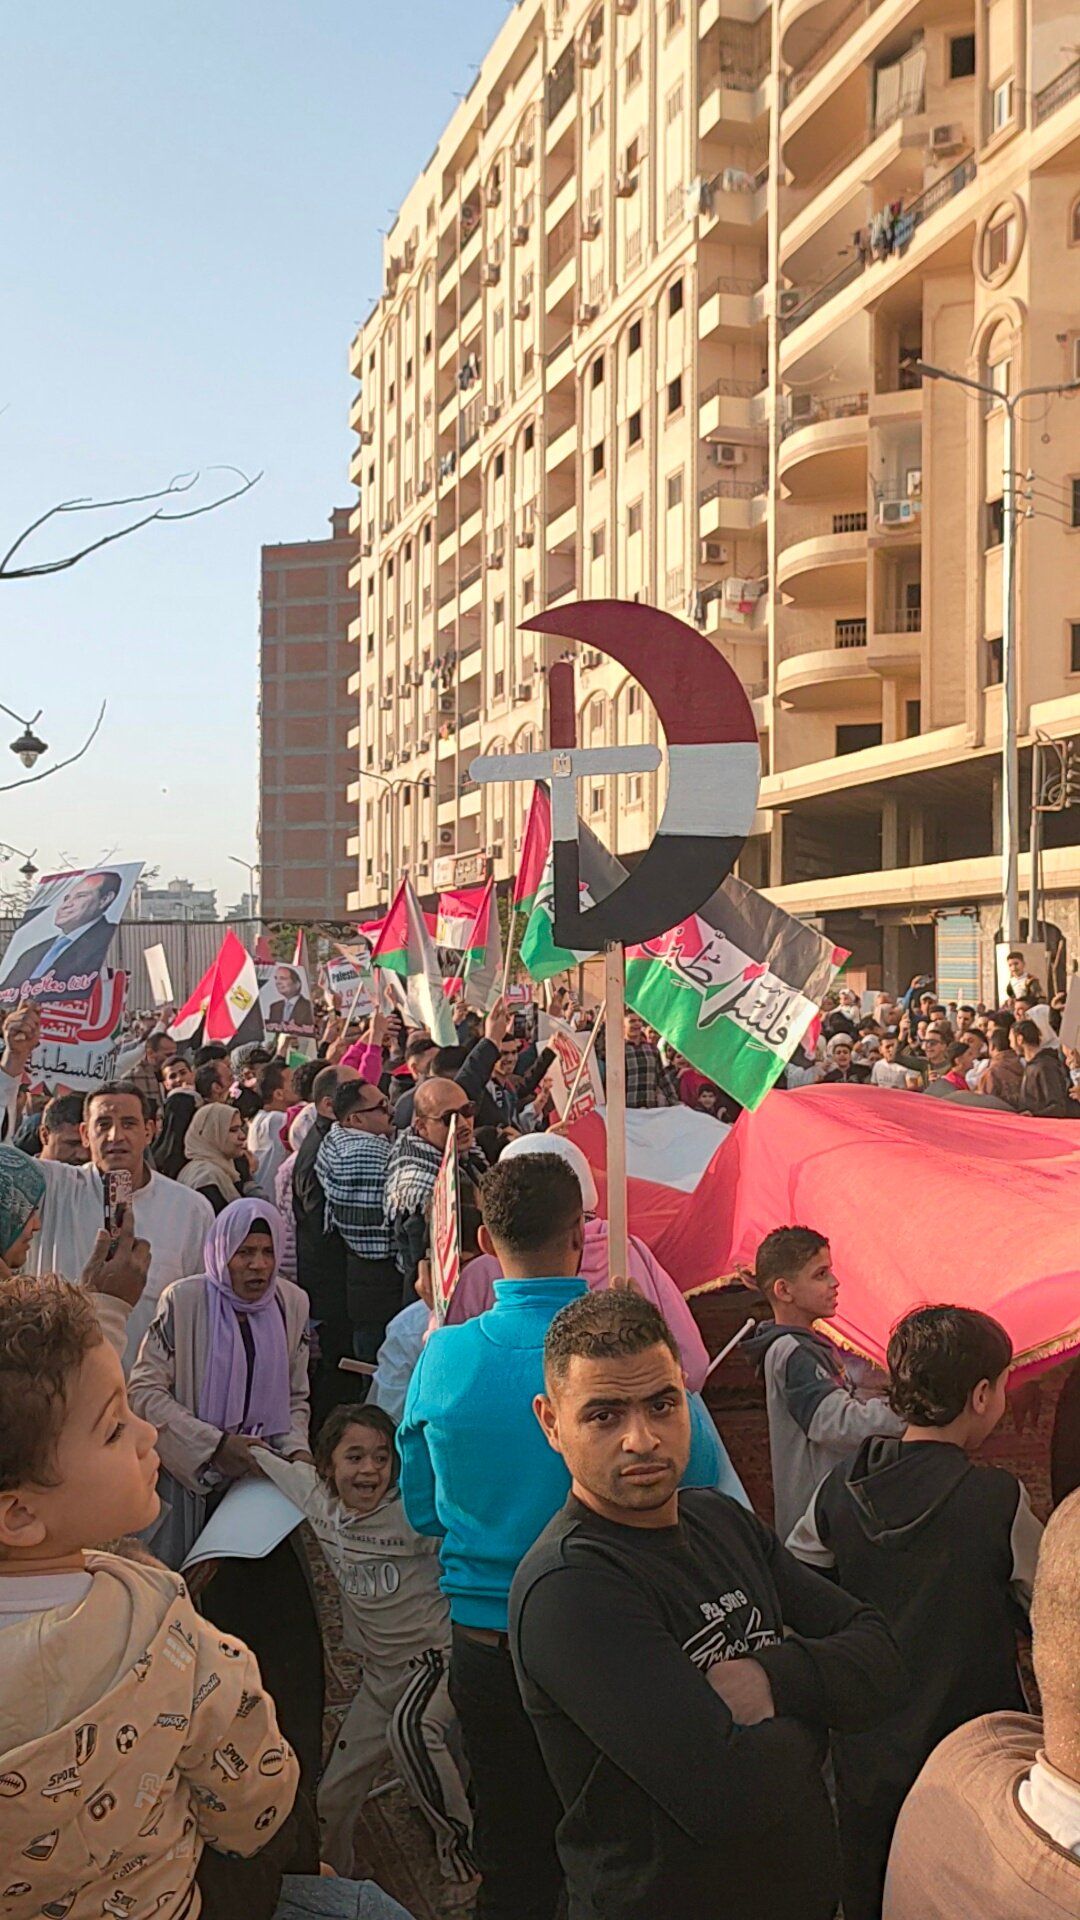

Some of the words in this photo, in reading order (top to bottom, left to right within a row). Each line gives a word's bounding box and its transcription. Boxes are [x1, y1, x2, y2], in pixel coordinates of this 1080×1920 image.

[40, 1000, 88, 1015] لتصفي
[40, 1022, 76, 1039] القضي
[48, 1766, 80, 1787] SPOR
